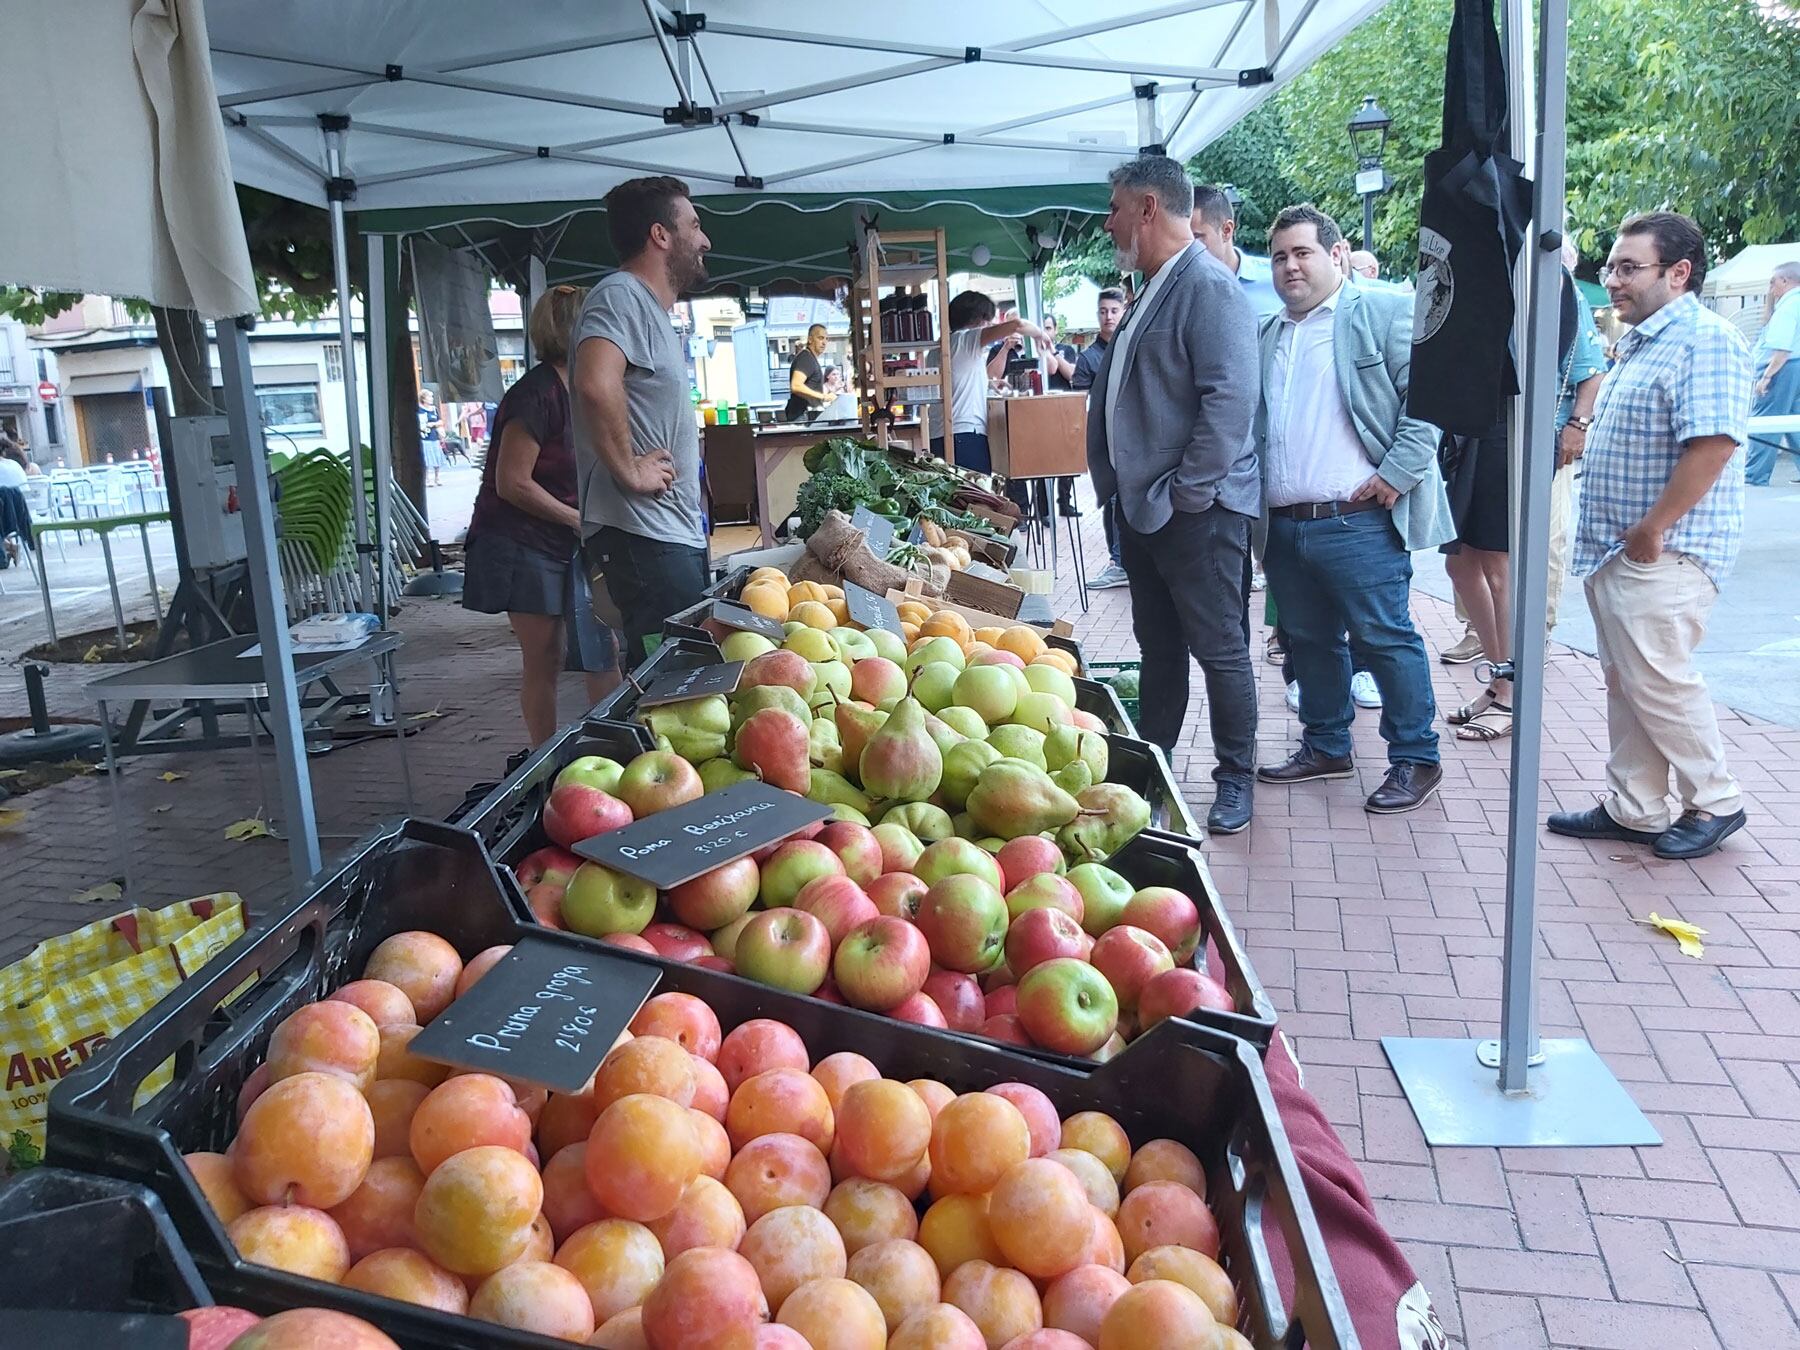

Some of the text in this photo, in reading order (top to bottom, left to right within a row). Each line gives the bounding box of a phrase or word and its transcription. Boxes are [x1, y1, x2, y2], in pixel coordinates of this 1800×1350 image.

[619, 838, 672, 860] Poma
[466, 965, 593, 1052] Pruna groga
